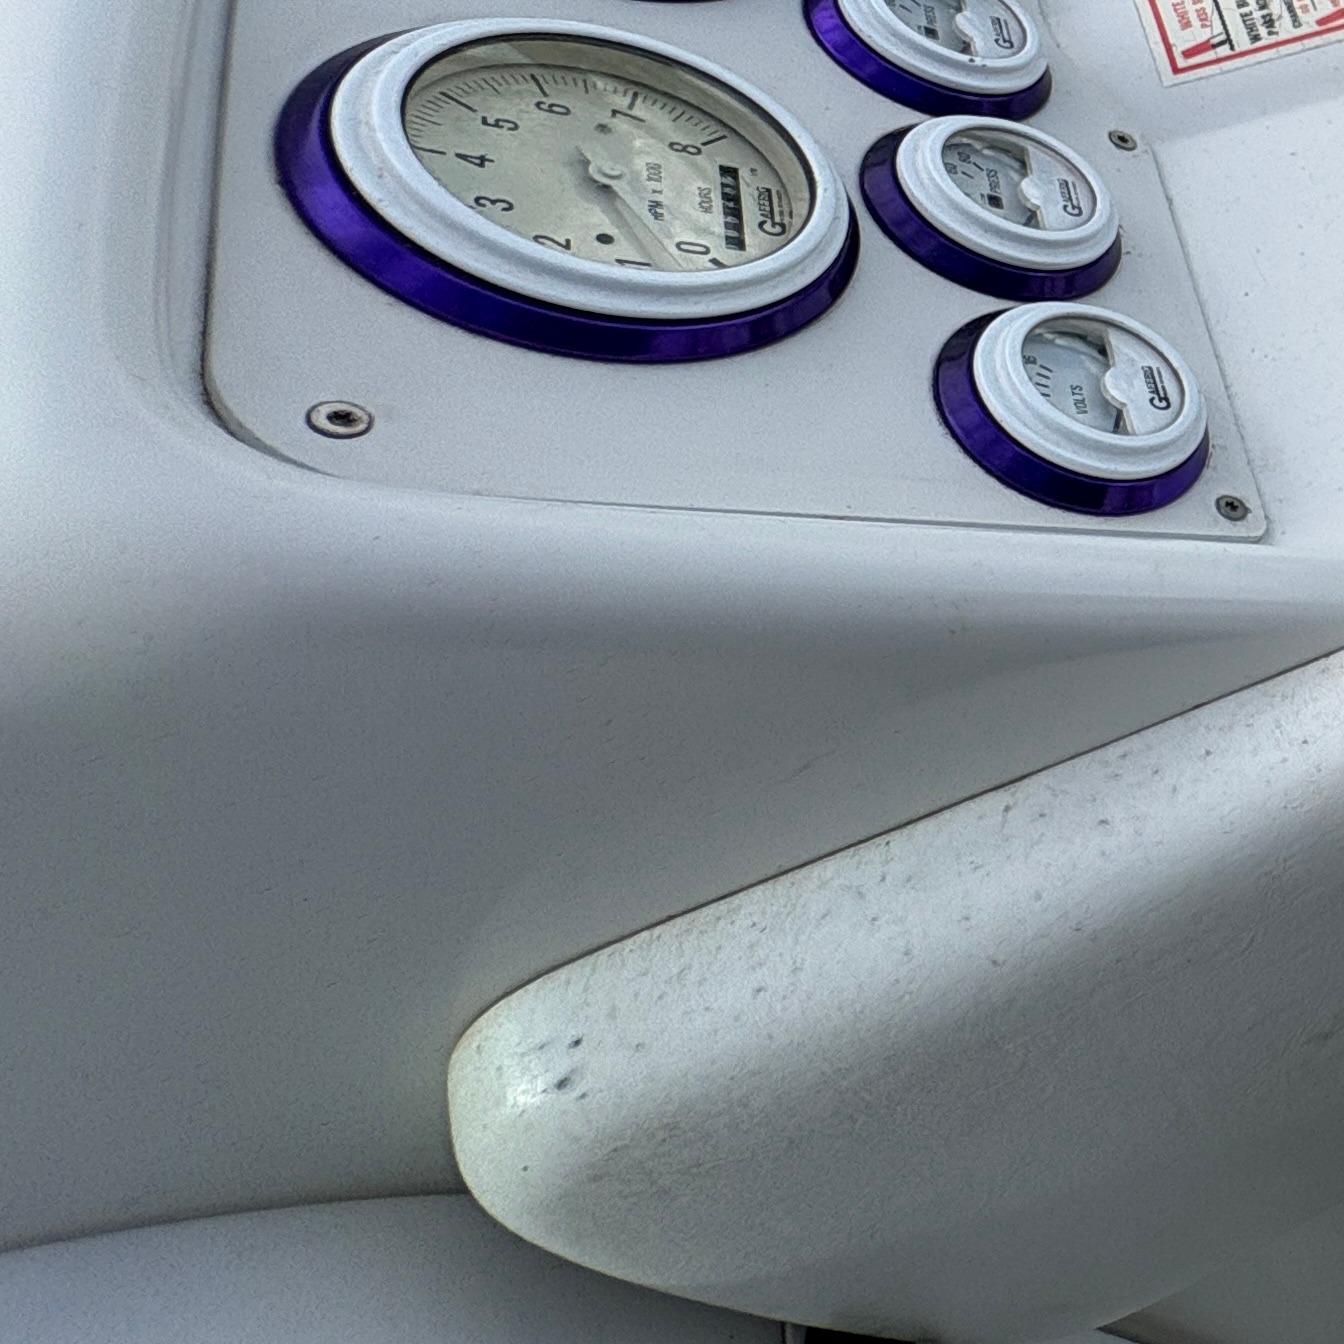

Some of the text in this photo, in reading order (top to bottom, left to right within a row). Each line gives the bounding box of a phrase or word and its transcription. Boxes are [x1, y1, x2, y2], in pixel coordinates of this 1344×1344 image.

[1238, 9, 1265, 44] WHITE
[1259, 11, 1282, 37] PASS
[533, 100, 572, 116] 6
[610, 108, 646, 123] 7
[481, 115, 520, 131] 5
[668, 141, 703, 156] 8
[454, 151, 495, 169] 4
[473, 195, 514, 212] 3
[697, 187, 713, 215] HOURS
[532, 233, 572, 252] 2
[675, 239, 711, 256] 0
[615, 256, 652, 268] 1
[1070, 384, 1089, 415] VOLTS
